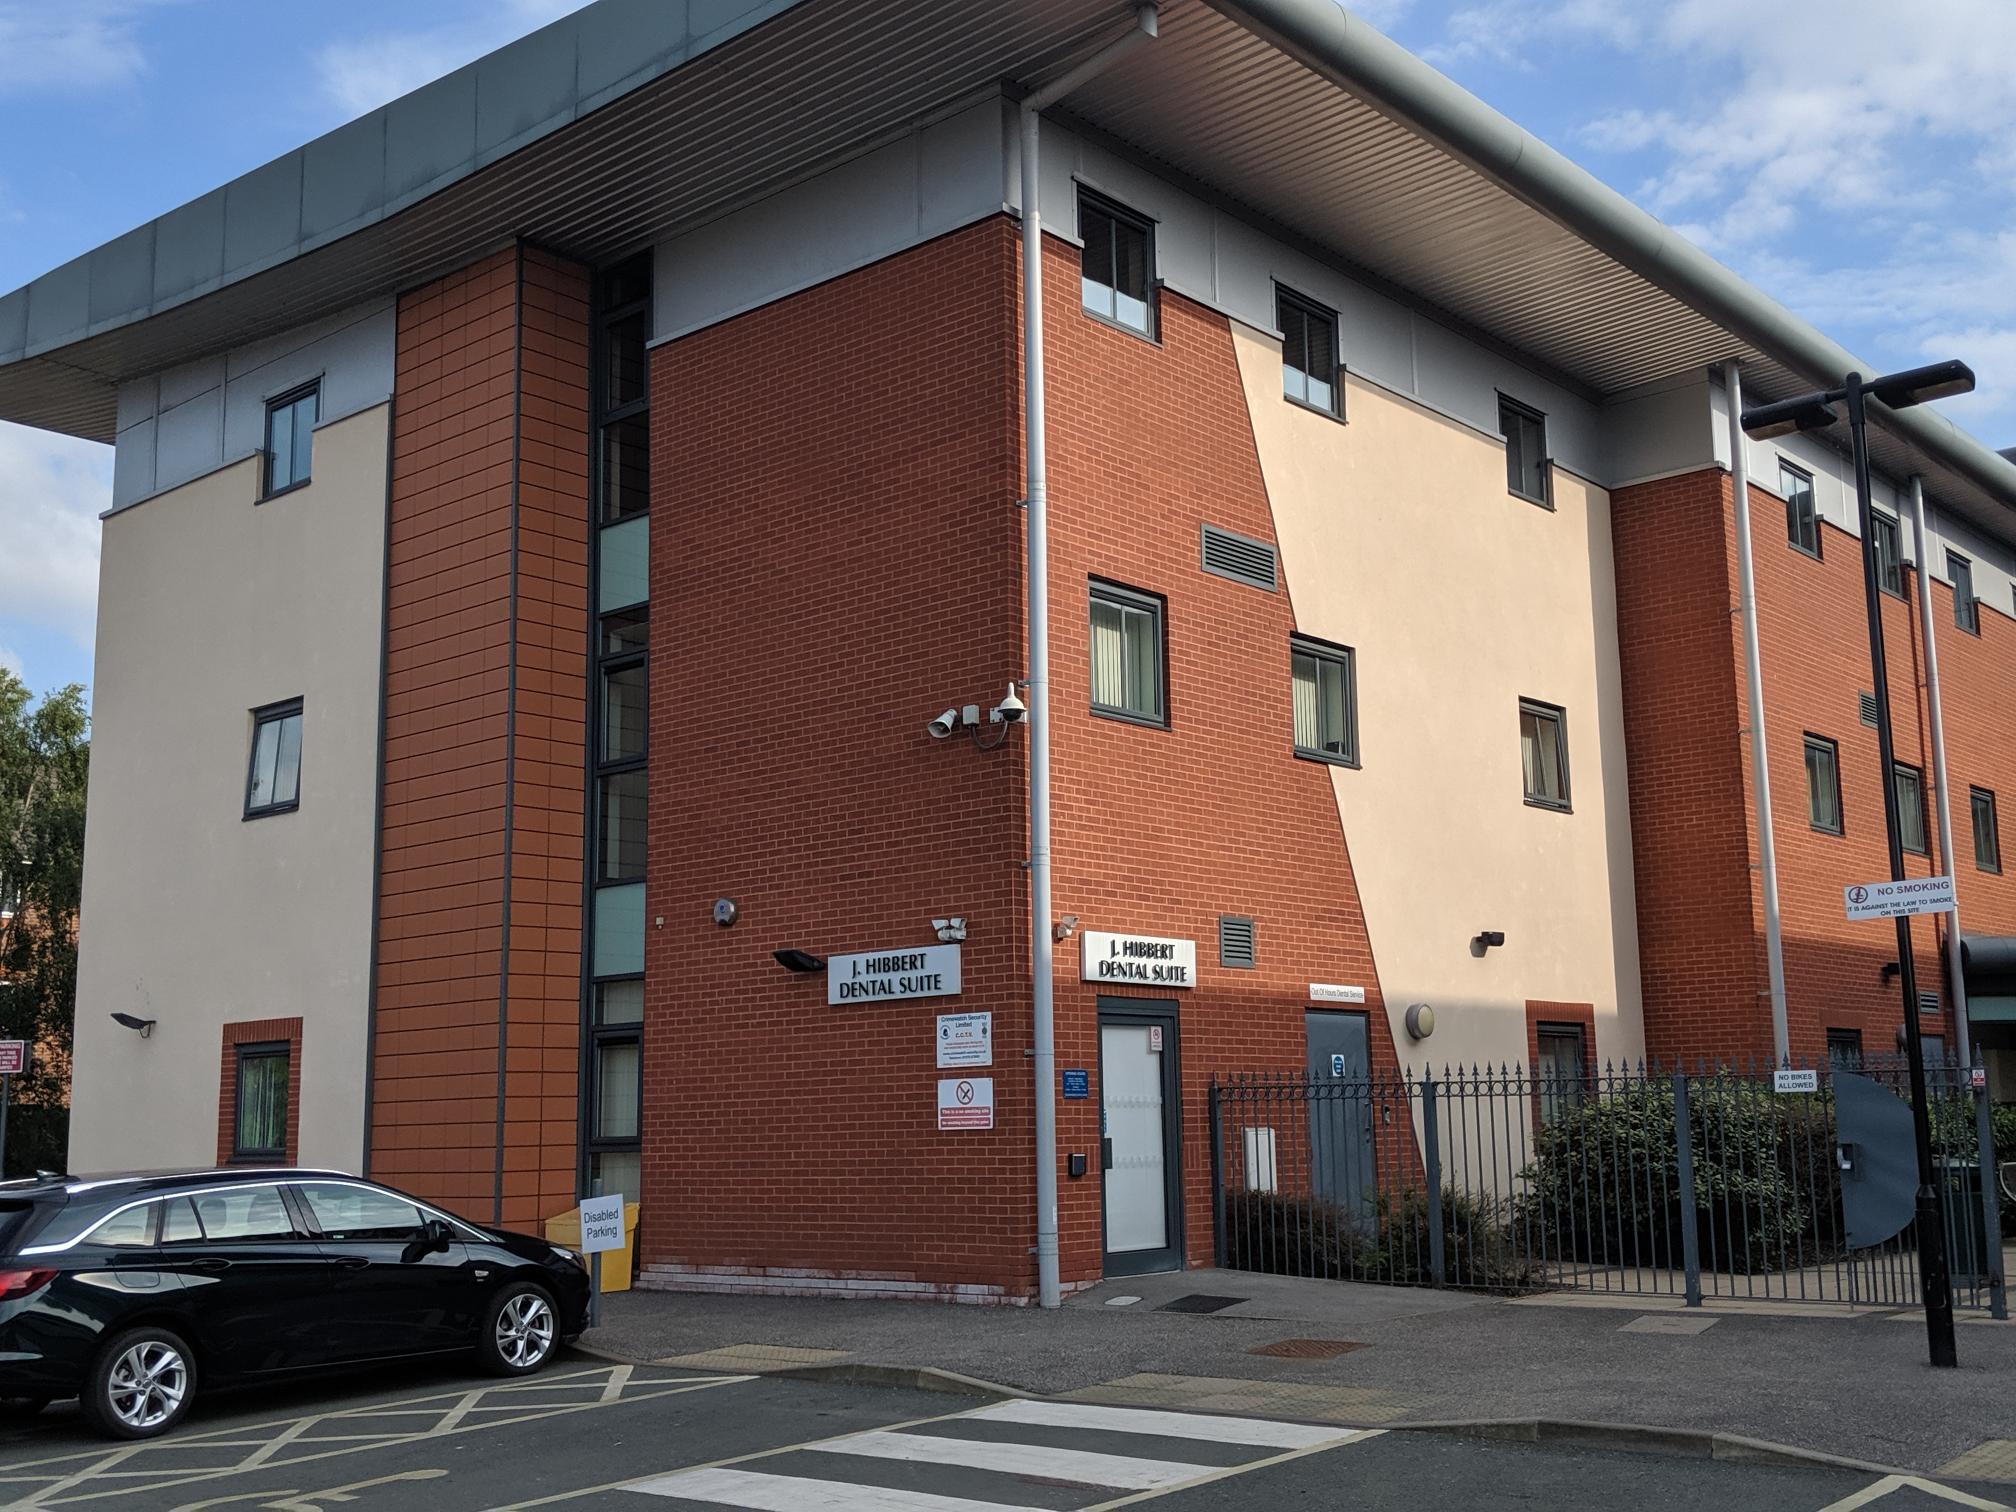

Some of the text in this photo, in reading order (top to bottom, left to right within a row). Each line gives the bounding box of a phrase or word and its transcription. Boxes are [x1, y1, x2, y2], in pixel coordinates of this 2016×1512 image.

[1877, 881, 1950, 896] NO SMOKING
[1110, 939, 1175, 960] J. HIBBERT
[852, 953, 926, 978] J. HIBBERT
[1098, 960, 1188, 982] DENTAL SUITE
[840, 974, 942, 998] DENTAL SUITE
[584, 1208, 619, 1223] Disabled
[587, 1226, 617, 1239] Parking
